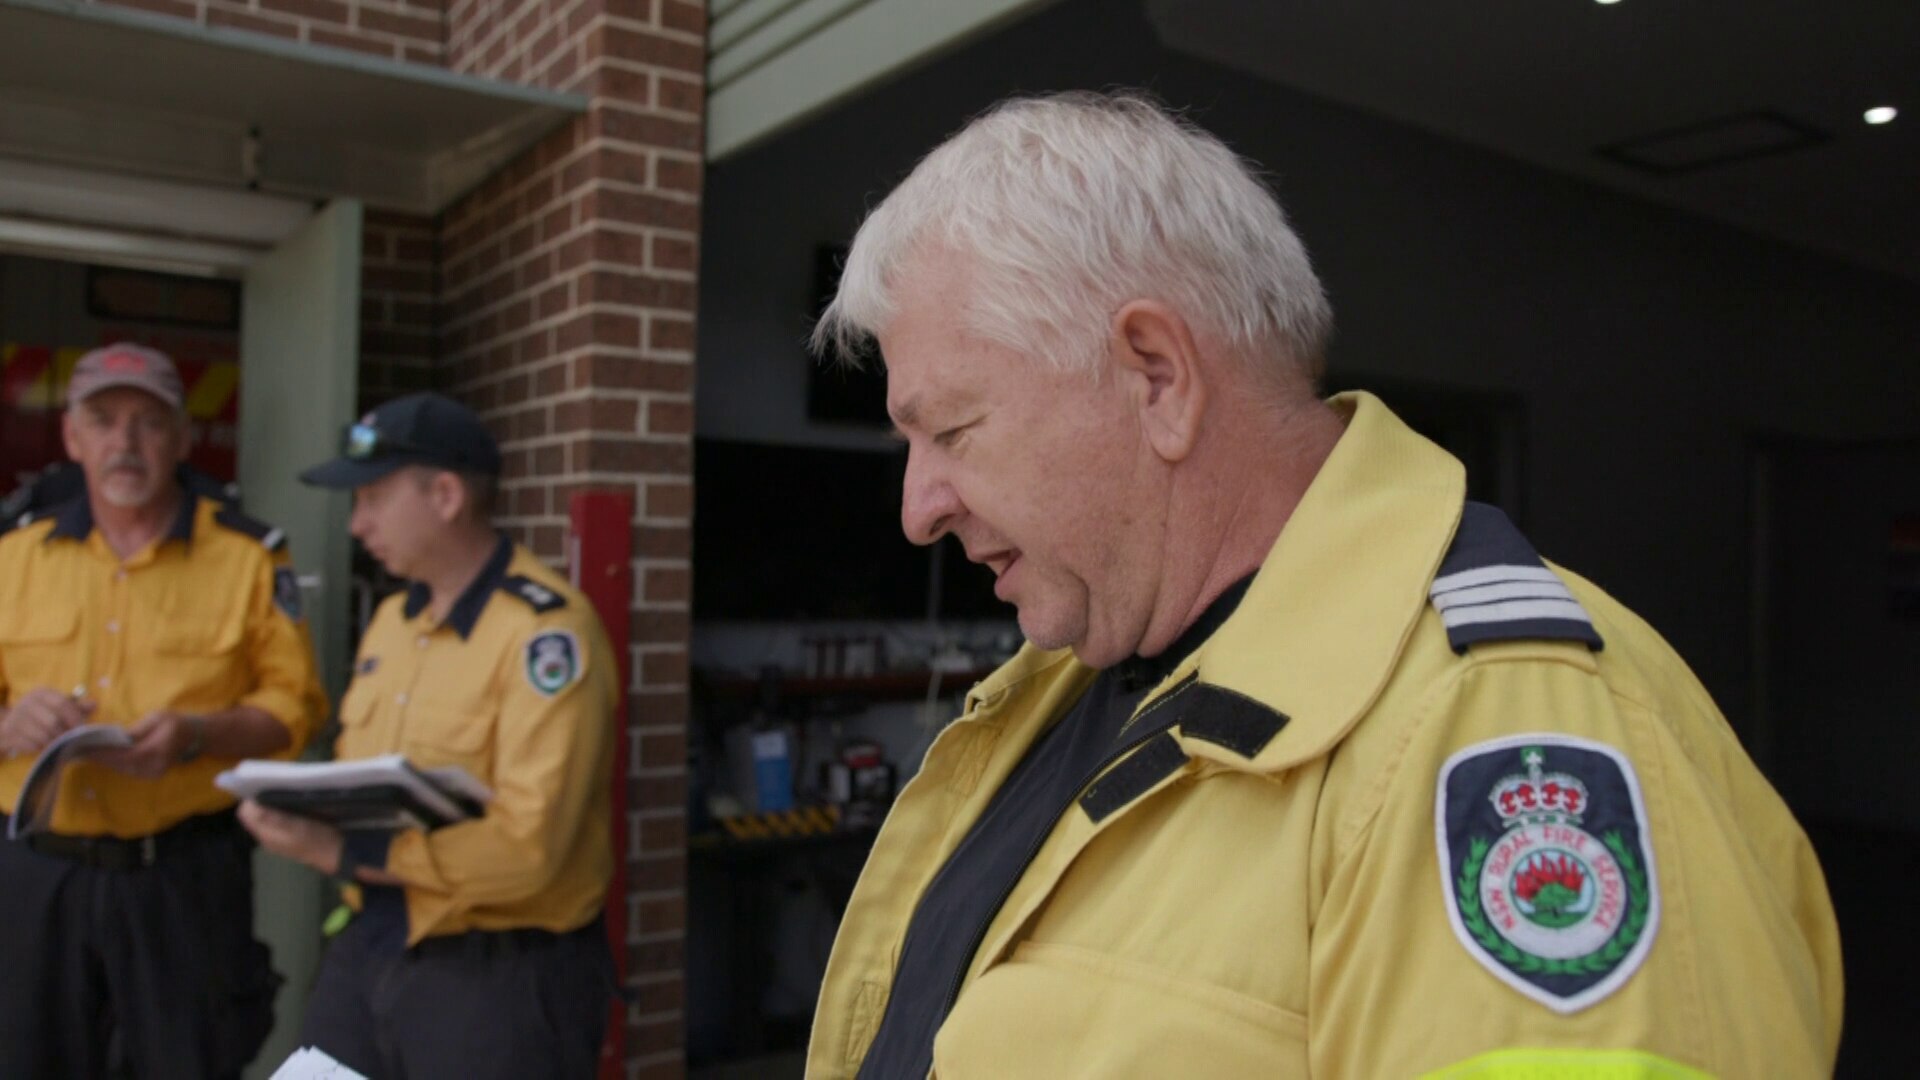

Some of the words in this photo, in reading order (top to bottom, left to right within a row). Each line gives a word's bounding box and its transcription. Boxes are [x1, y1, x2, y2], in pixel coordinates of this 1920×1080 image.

[1489, 831, 1533, 876] RURAL
[1543, 825, 1588, 852] FIRE
[1592, 853, 1620, 930] SERVICE
